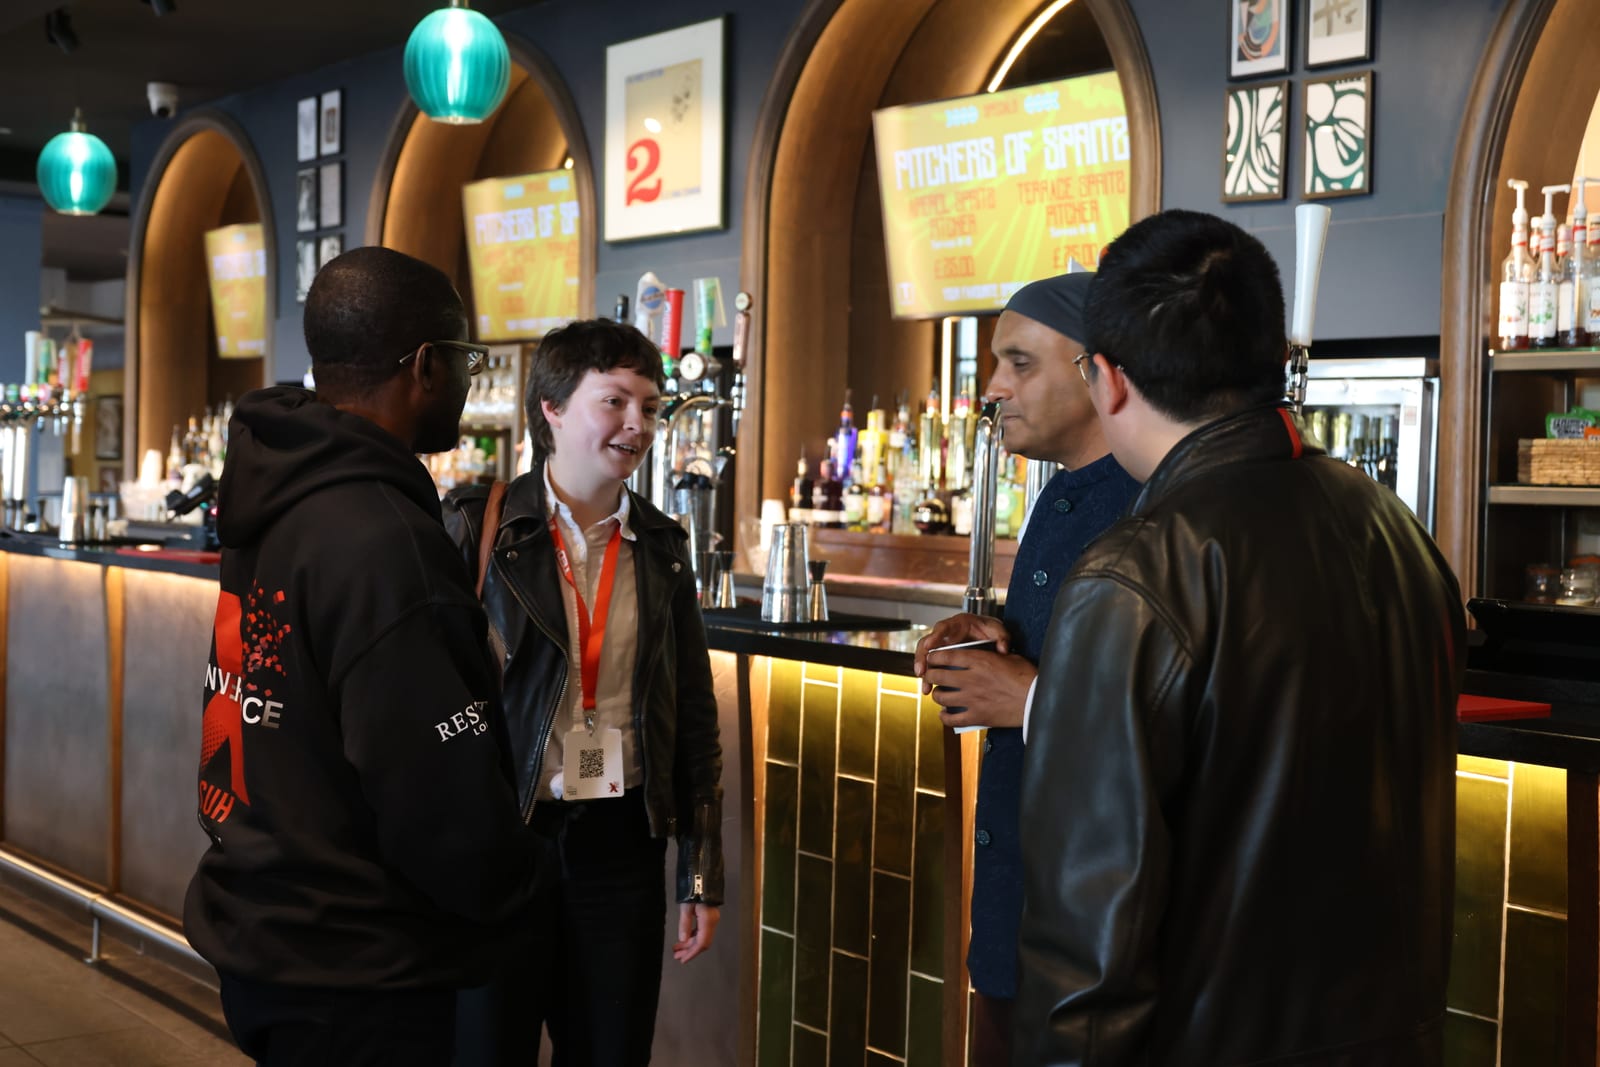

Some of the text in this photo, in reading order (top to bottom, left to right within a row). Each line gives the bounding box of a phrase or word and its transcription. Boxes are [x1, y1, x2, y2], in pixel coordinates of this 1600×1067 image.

[625, 138, 662, 206] 2
[894, 136, 997, 189] PITCHERS
[1003, 131, 1033, 176] OF
[1046, 199, 1100, 228] PITCHER
